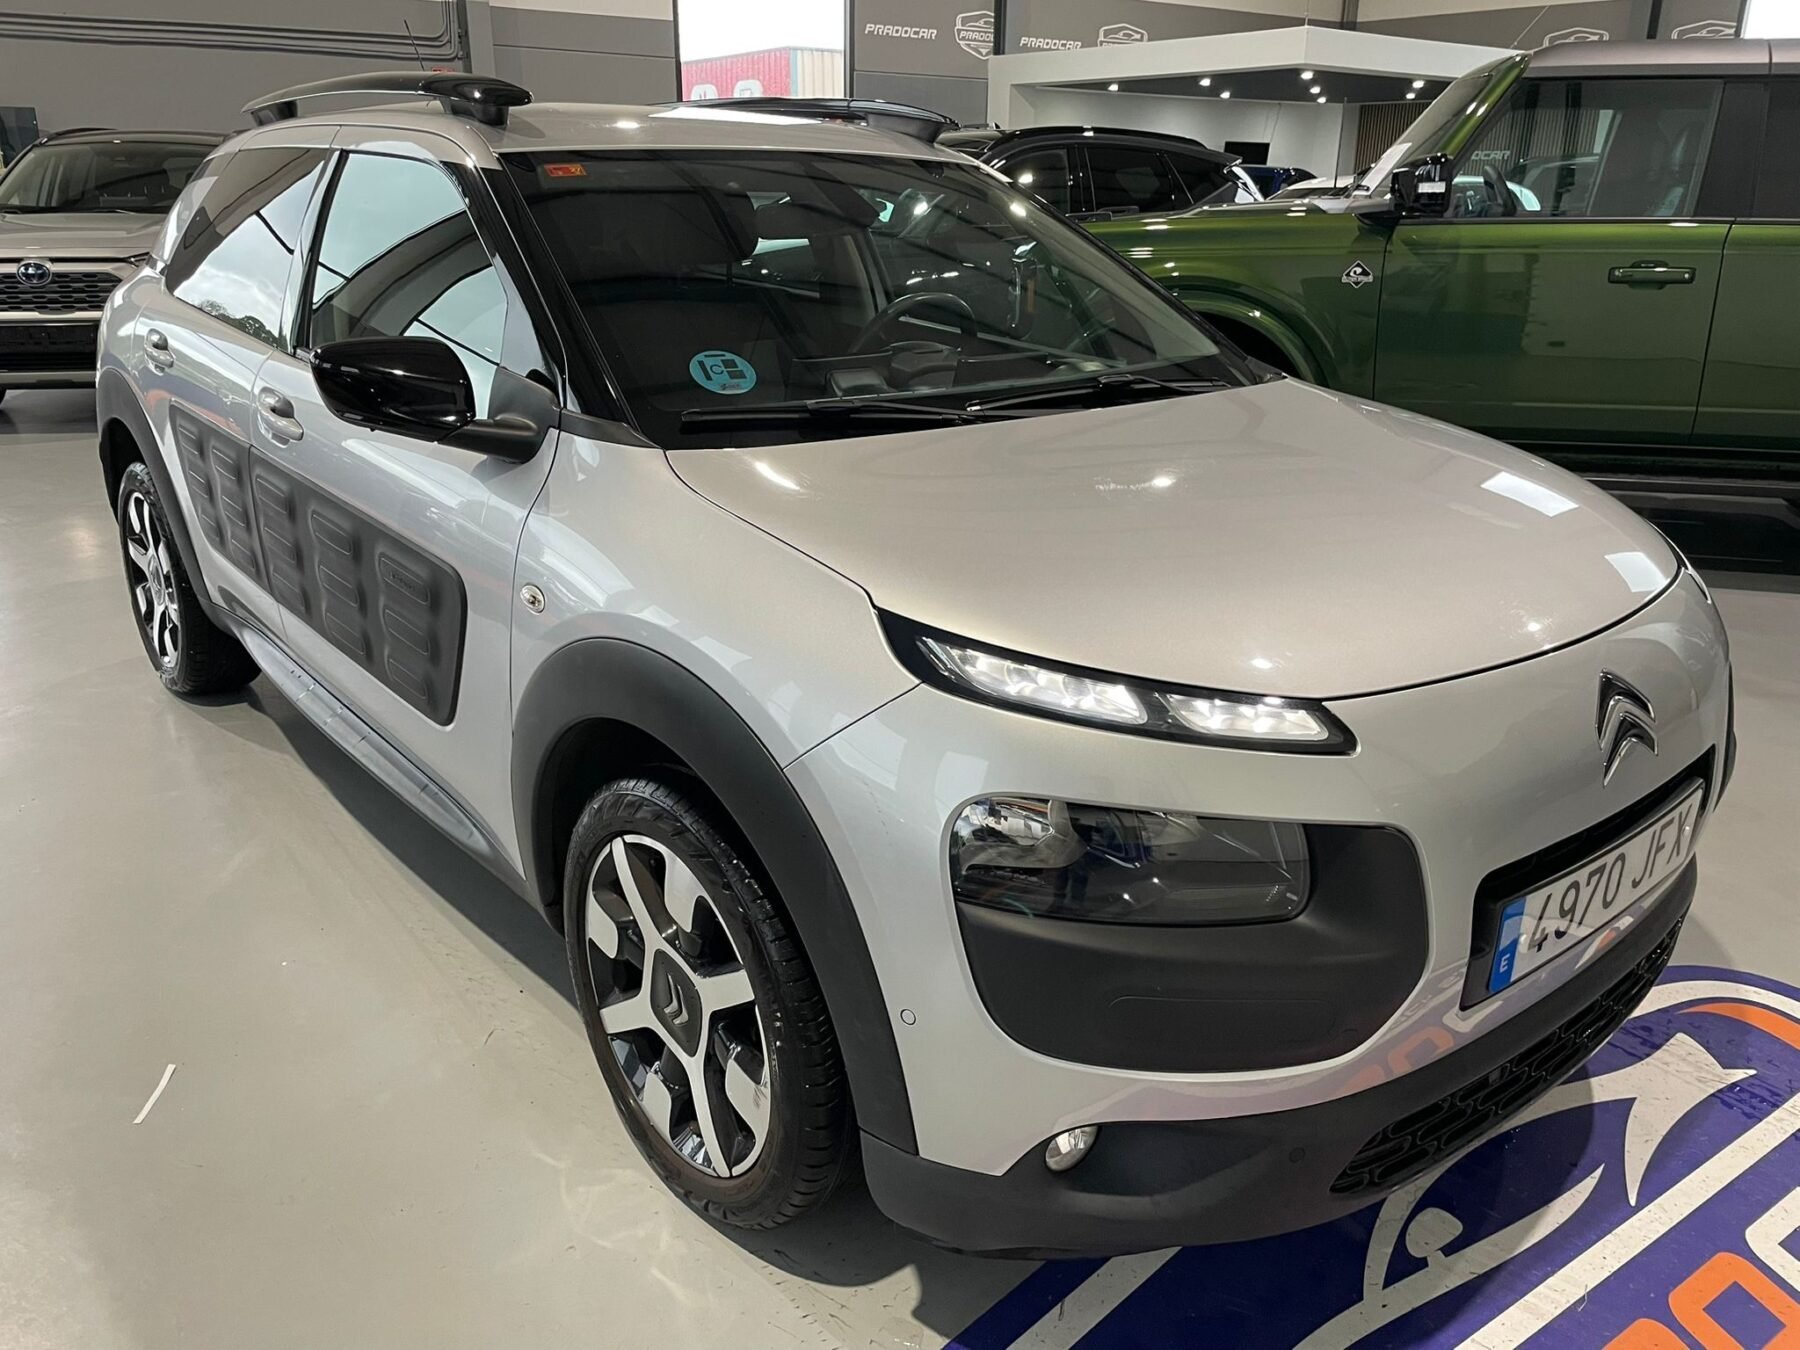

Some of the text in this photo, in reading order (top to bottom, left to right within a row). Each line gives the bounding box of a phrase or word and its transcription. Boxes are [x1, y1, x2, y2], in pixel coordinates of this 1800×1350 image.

[865, 23, 937, 39] PRADOCAR
[1020, 36, 1082, 50] PRADOCAR
[1527, 803, 1693, 953] 4970 JFX
[1499, 953, 1511, 973] E
